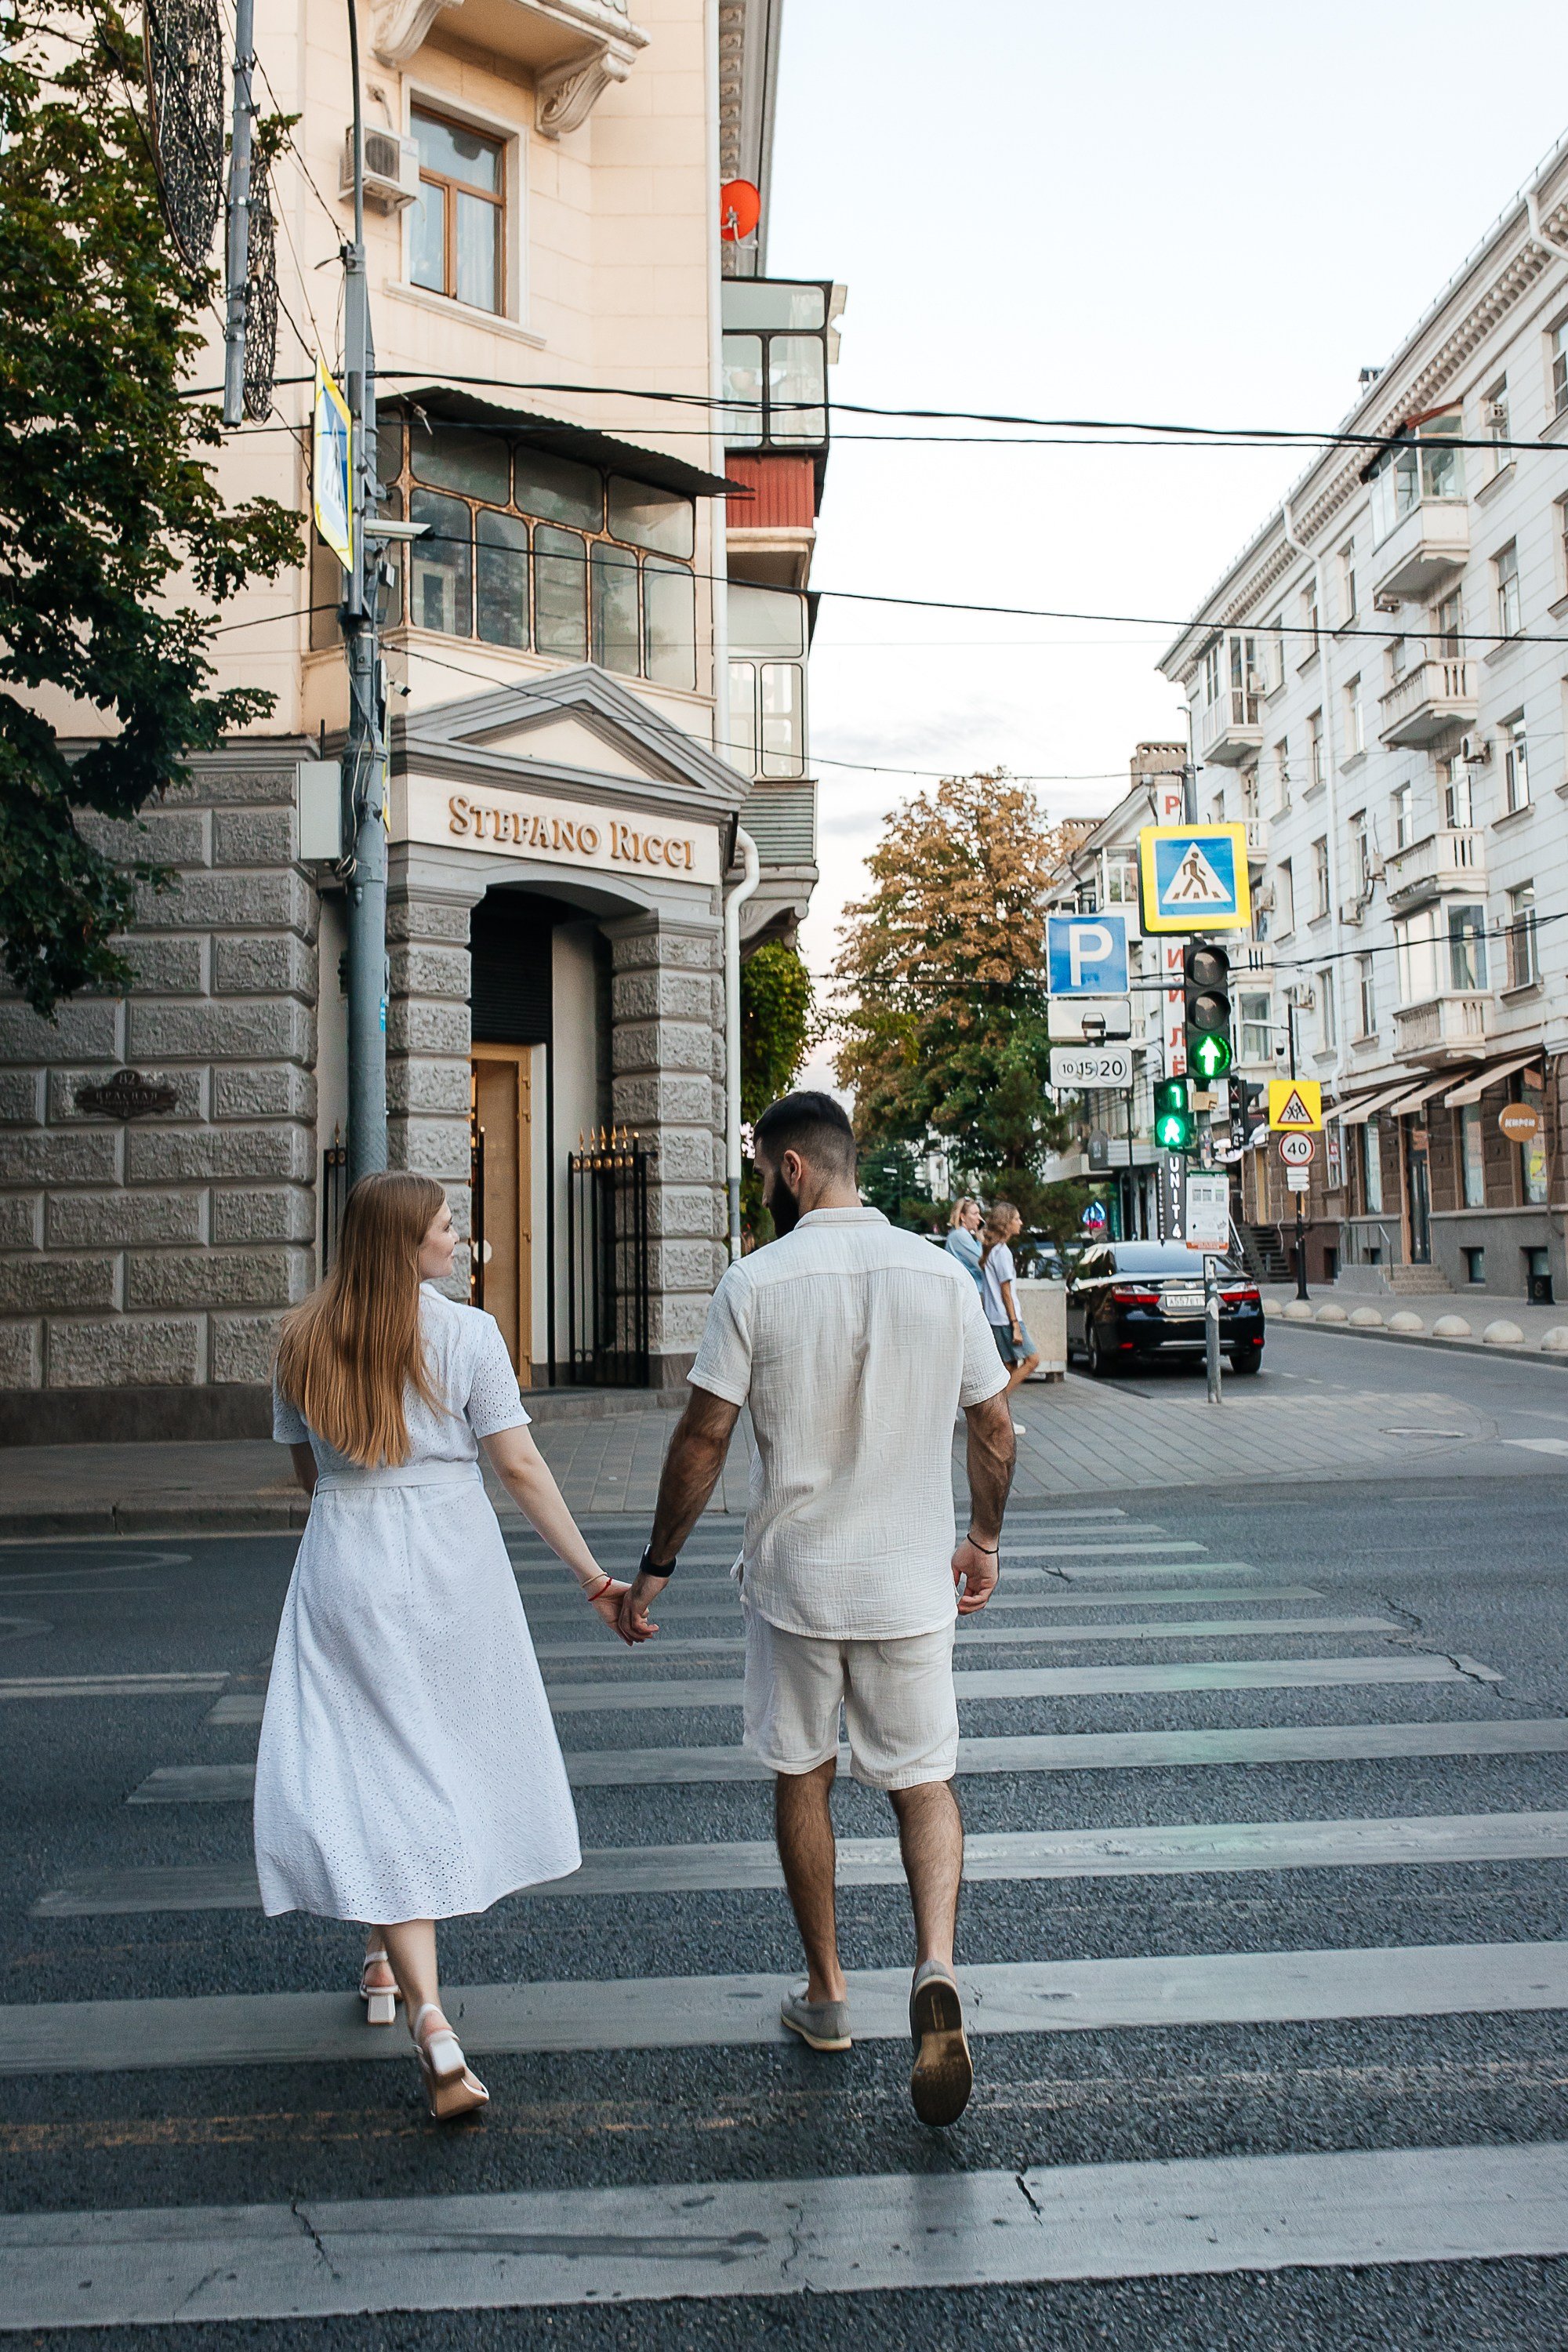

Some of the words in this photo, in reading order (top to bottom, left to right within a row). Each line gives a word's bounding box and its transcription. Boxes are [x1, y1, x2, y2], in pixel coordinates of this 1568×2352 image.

[449, 794, 602, 855] STEFANO
[610, 820, 696, 870] RICCI
[1069, 924, 1112, 987] P
[1062, 1064, 1074, 1074] 10
[1080, 1062, 1093, 1076] 15
[1100, 1060, 1123, 1076] 20
[96, 1091, 158, 1101] КРАСНАЯ
[1287, 1142, 1307, 1156] 40
